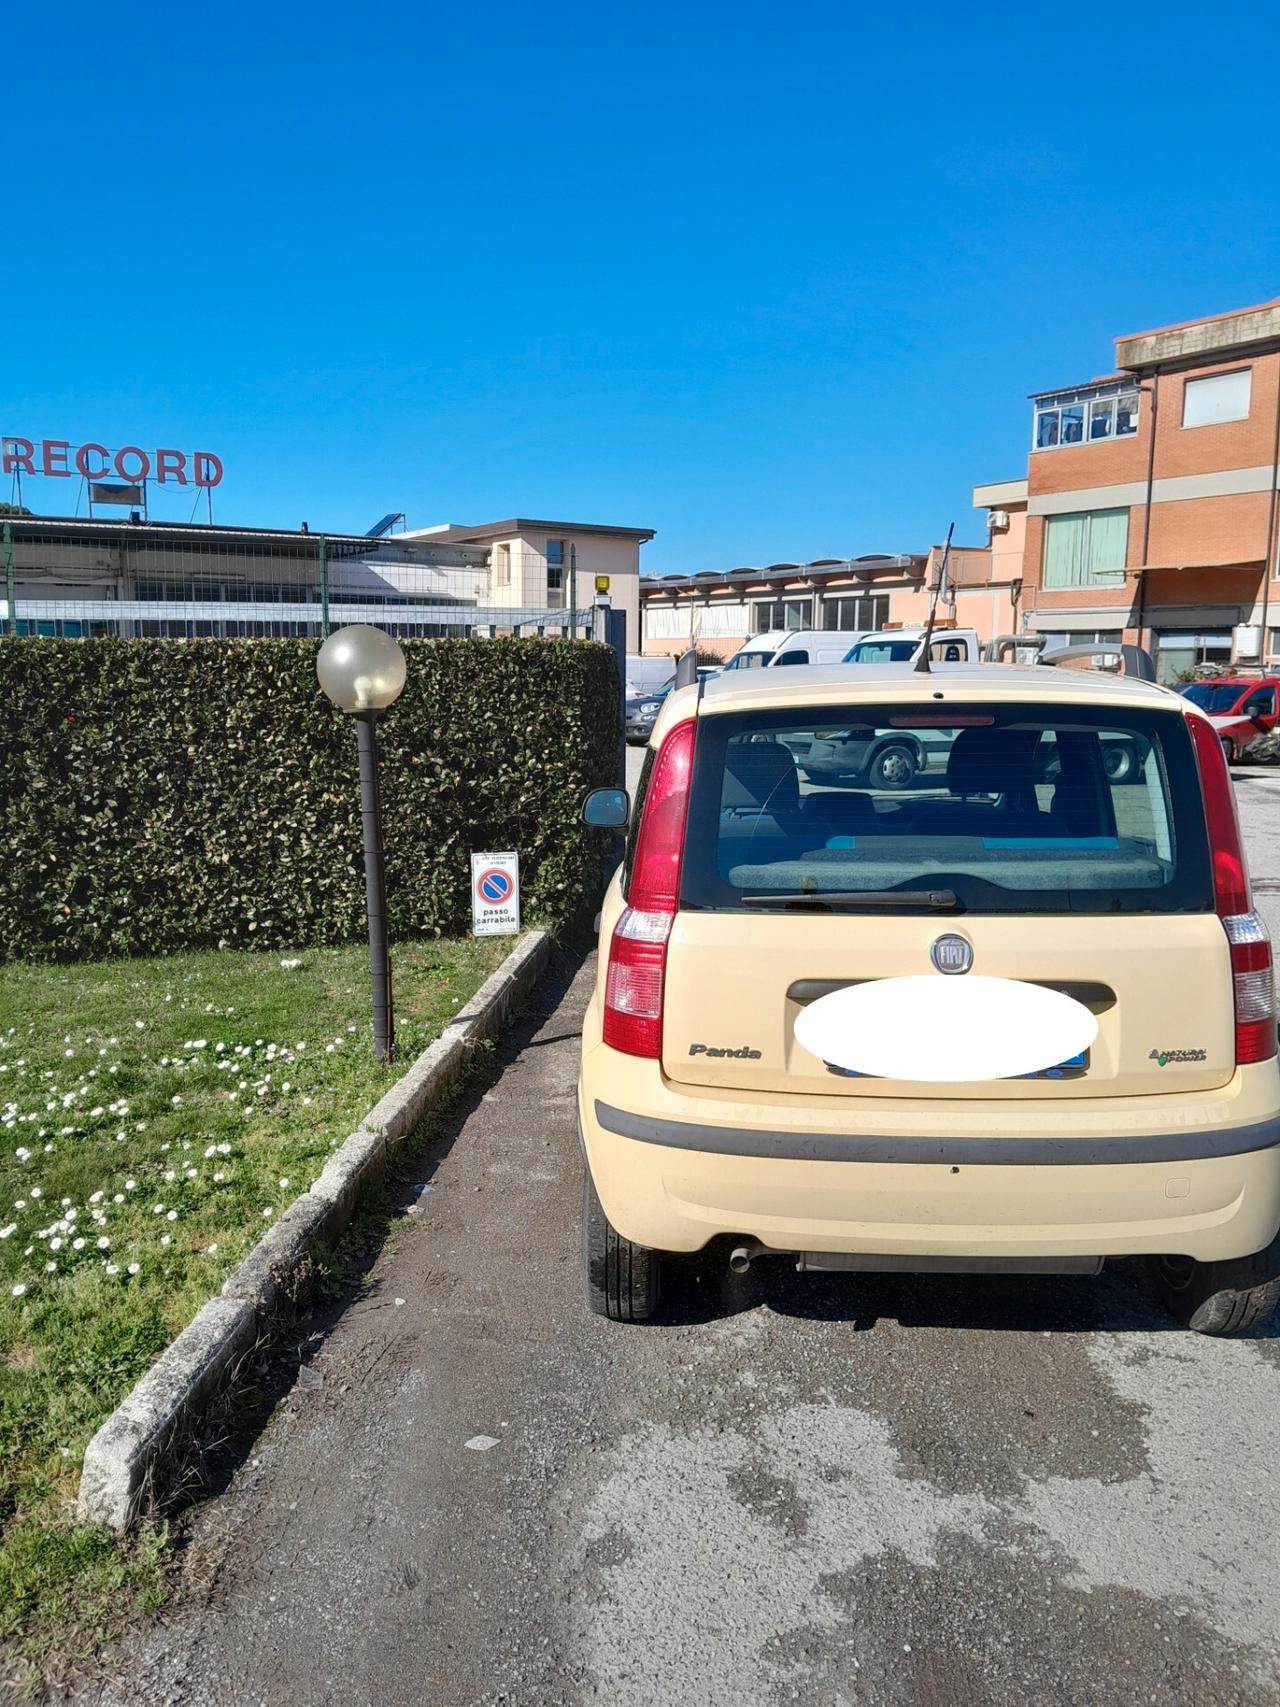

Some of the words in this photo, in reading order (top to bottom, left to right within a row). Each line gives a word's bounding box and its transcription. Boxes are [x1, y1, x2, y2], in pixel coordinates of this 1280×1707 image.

[2, 437, 224, 488] RECORD
[476, 916, 516, 925] carrabile
[940, 945, 965, 964] FIAT
[689, 1043, 762, 1060] Panda
[1167, 1054, 1207, 1063] POWER
